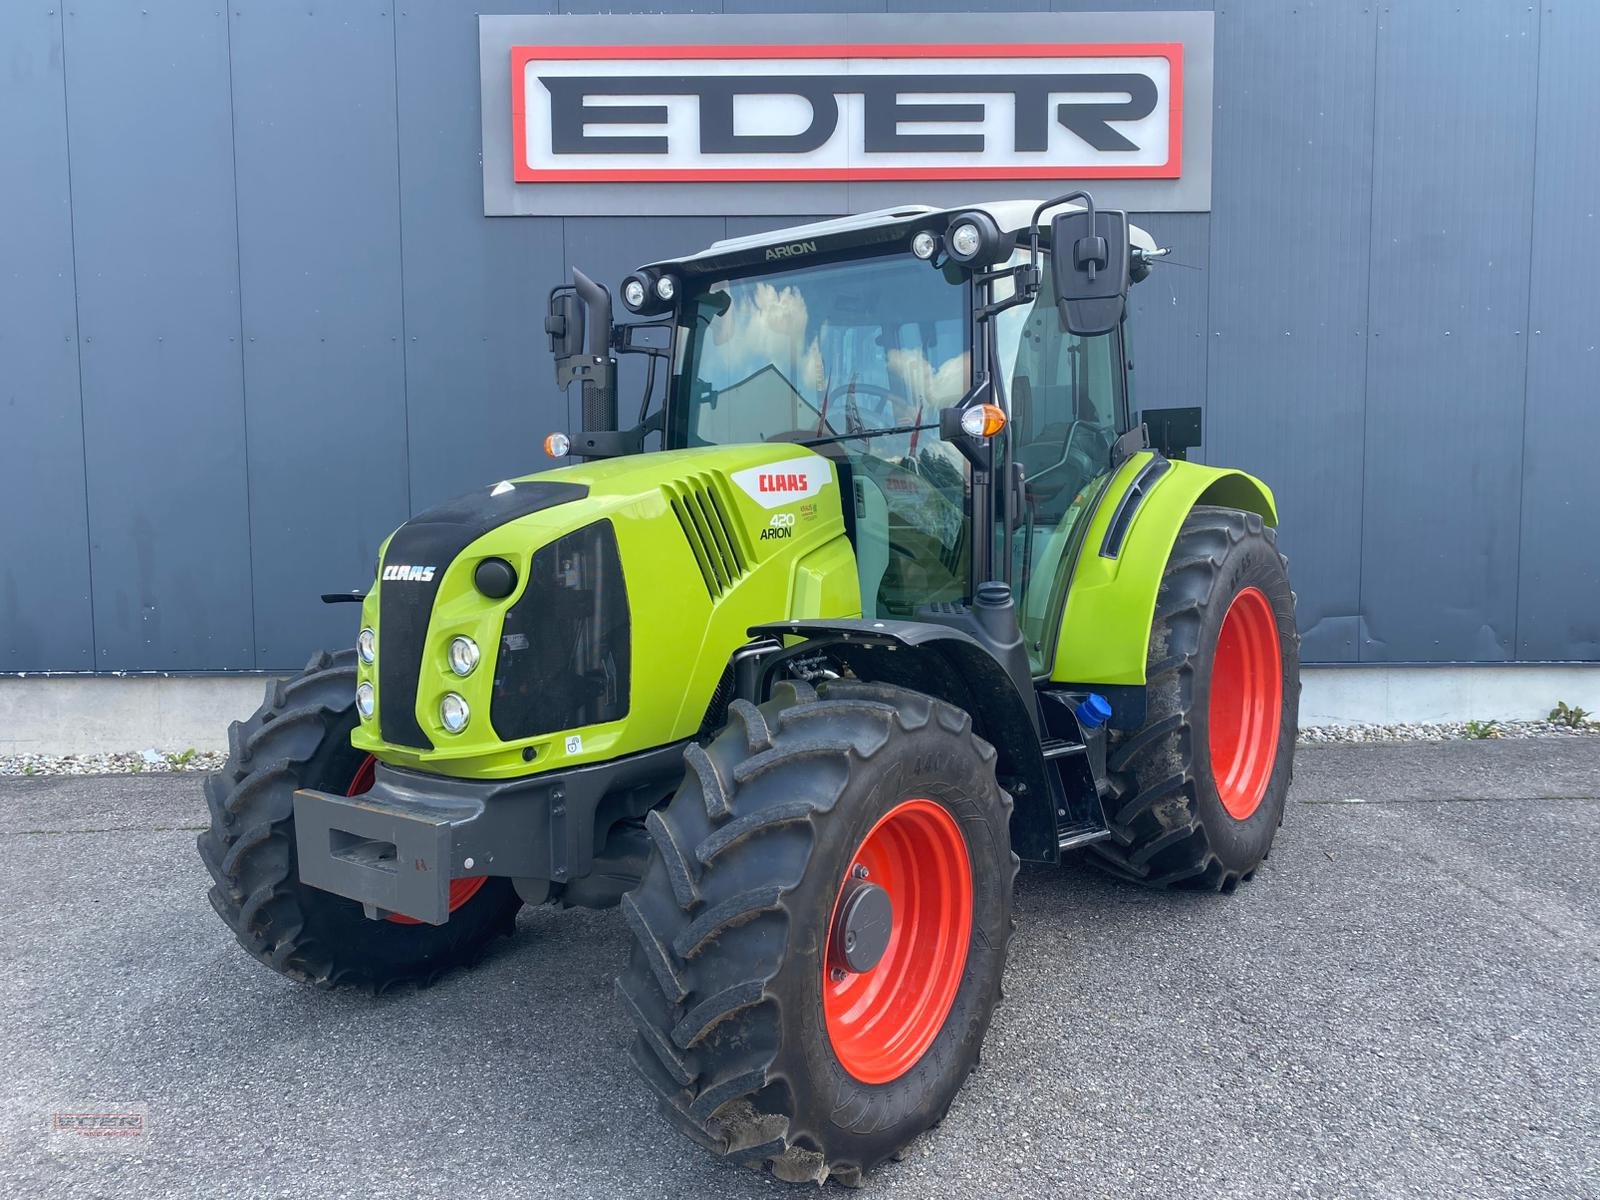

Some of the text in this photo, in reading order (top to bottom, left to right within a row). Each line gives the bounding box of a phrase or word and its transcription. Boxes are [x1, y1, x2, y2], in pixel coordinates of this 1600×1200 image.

[536, 73, 1159, 155] EDER
[765, 241, 817, 260] ARION
[758, 473, 808, 493] CLAAS
[769, 513, 796, 527] 420
[759, 526, 792, 541] ARION
[382, 565, 437, 582] CLAAS
